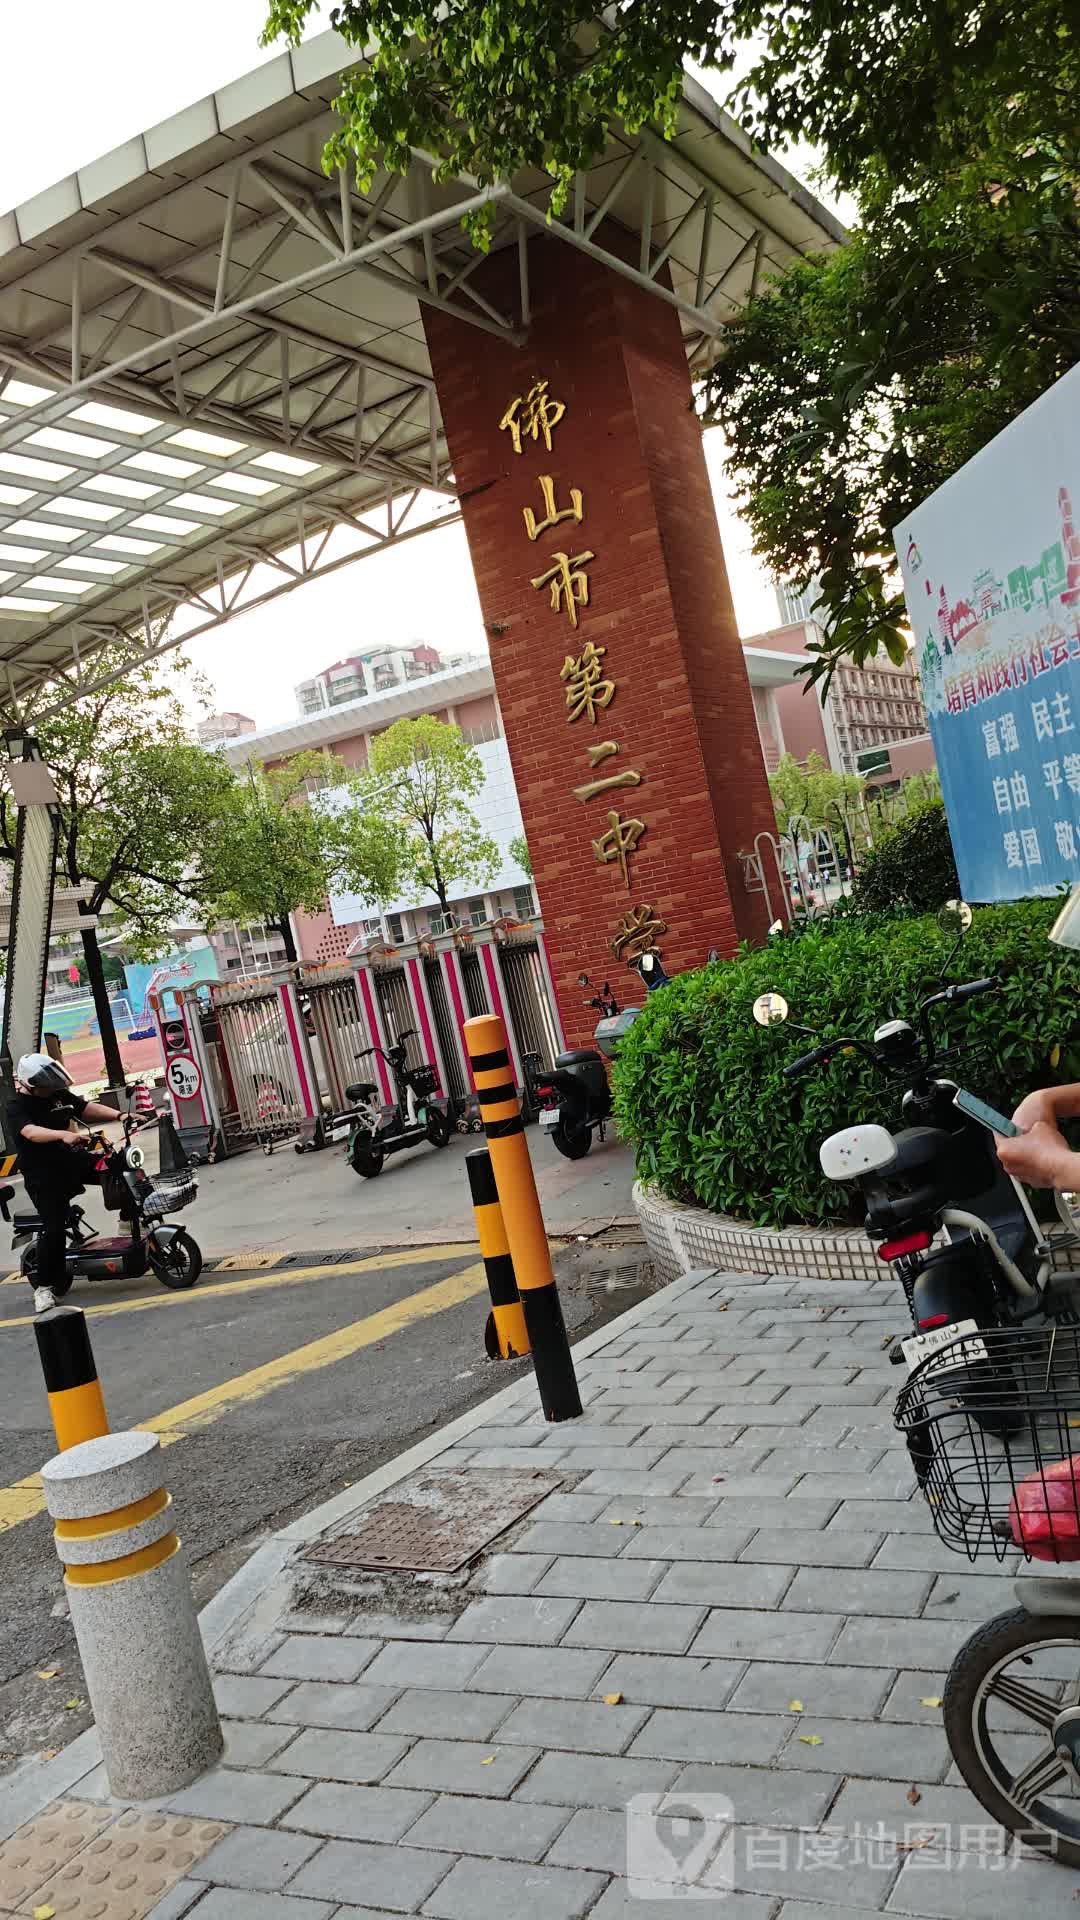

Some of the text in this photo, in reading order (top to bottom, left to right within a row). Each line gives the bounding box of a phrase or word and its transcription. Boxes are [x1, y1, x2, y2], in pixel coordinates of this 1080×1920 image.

[499, 376, 667, 970] 佛山市第二中学
[982, 691, 1075, 759] 富强 民主
[992, 753, 1080, 815] 自由 平等
[1003, 820, 1080, 868] 爱国 敬
